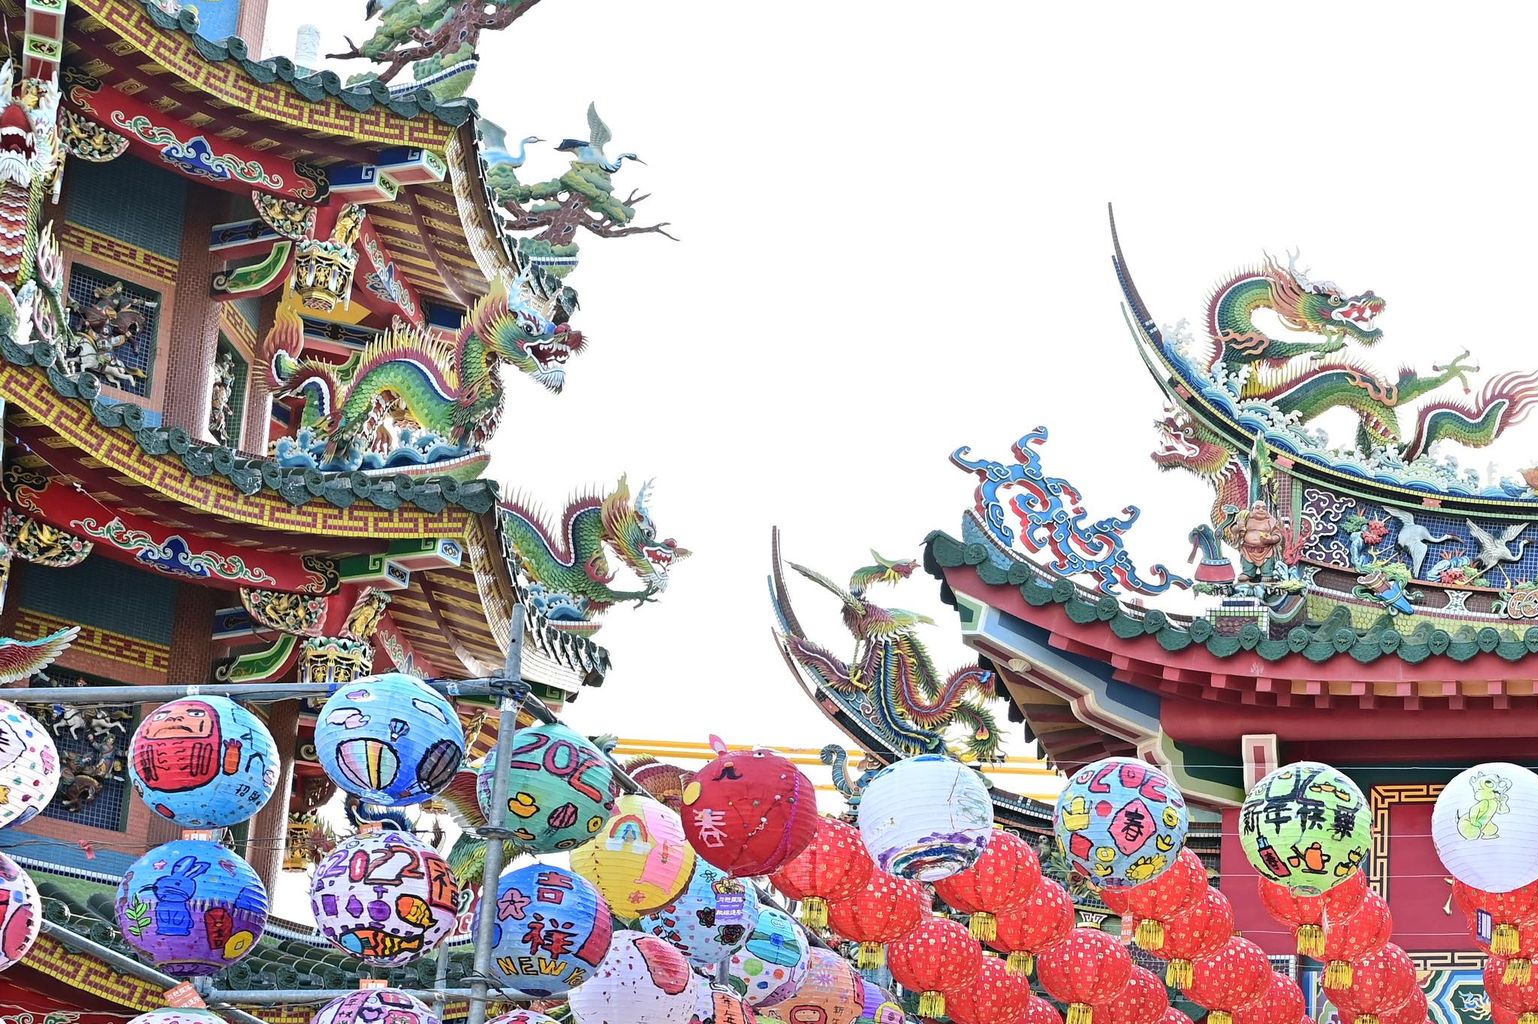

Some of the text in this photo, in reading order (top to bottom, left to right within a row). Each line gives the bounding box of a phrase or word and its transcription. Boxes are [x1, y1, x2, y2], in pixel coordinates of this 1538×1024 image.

[692, 808, 728, 849] 春
[1123, 808, 1145, 842] 春
[521, 871, 577, 959] 吉祥
[496, 956, 567, 977] NEW
